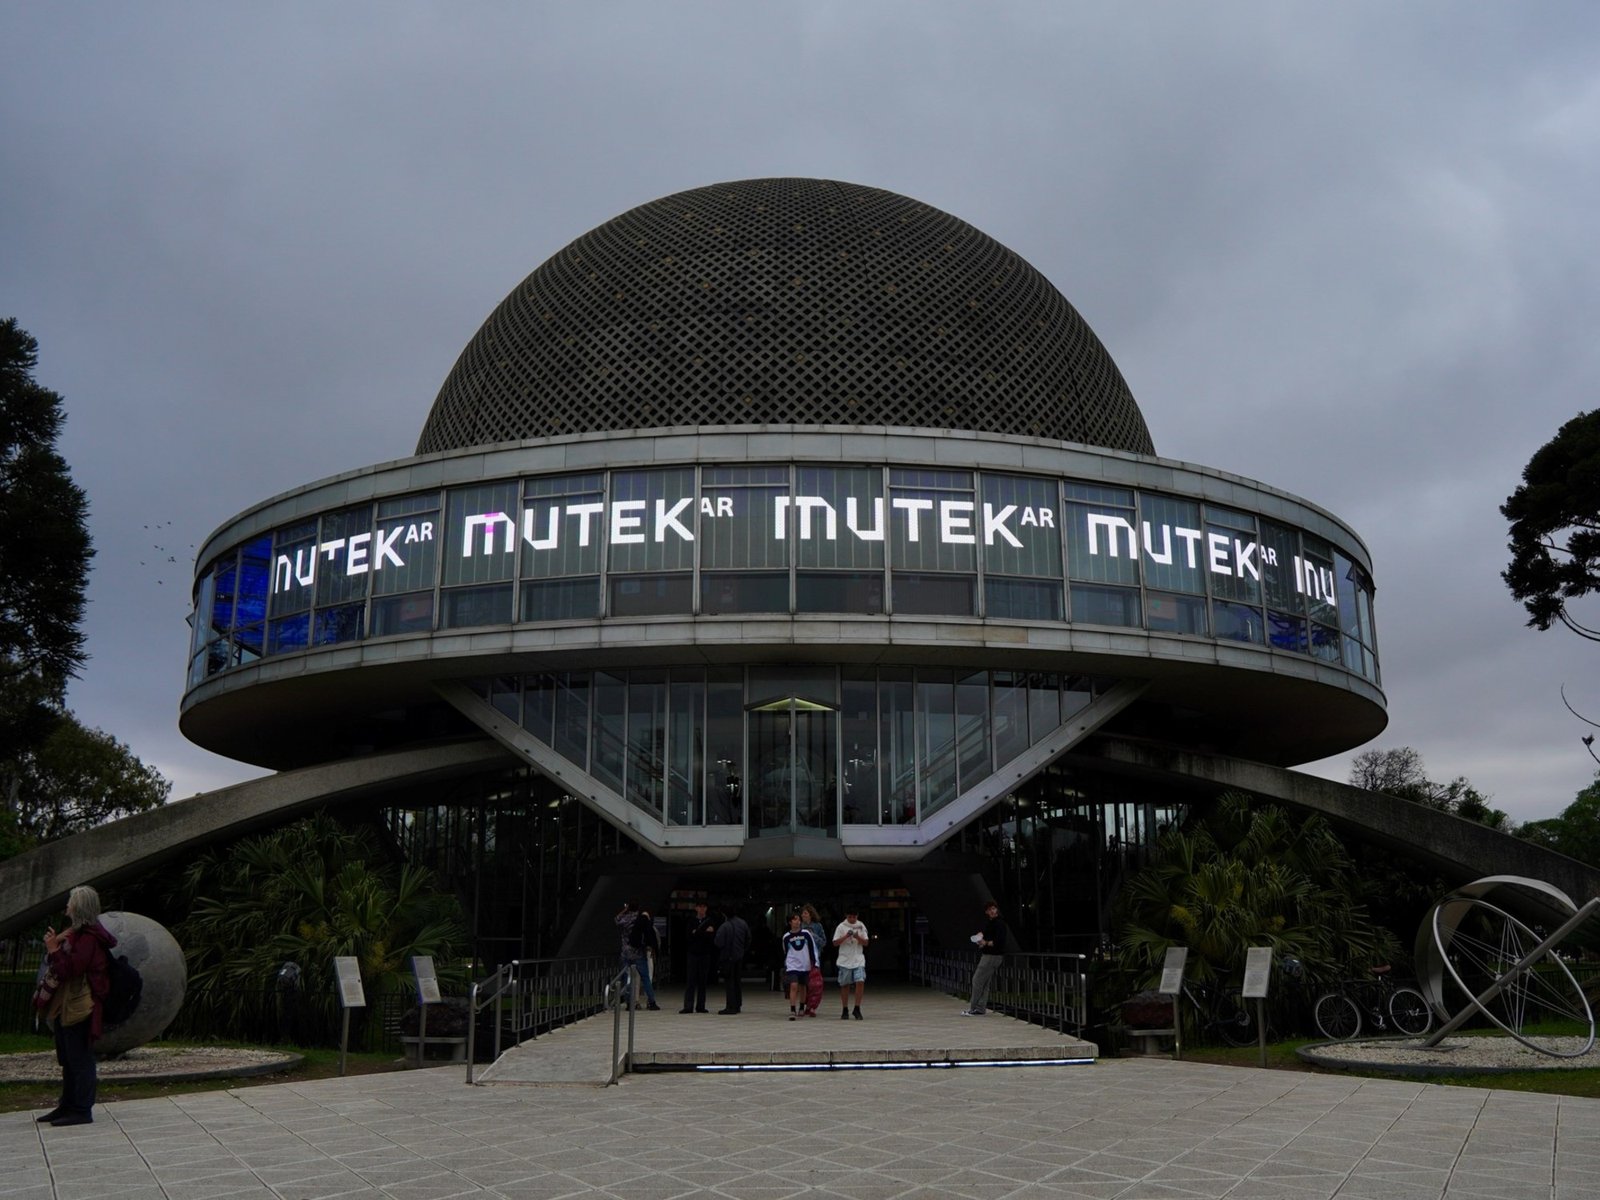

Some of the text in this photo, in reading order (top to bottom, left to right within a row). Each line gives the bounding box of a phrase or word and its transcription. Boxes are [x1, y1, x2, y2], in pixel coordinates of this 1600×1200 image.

[404, 521, 433, 544] AR
[462, 497, 695, 558] MUTEK
[700, 496, 734, 517] AR
[774, 495, 1024, 548] MUTEK
[1021, 506, 1055, 528] AR
[1087, 513, 1260, 581] MUTEK
[1260, 545, 1278, 567] AR
